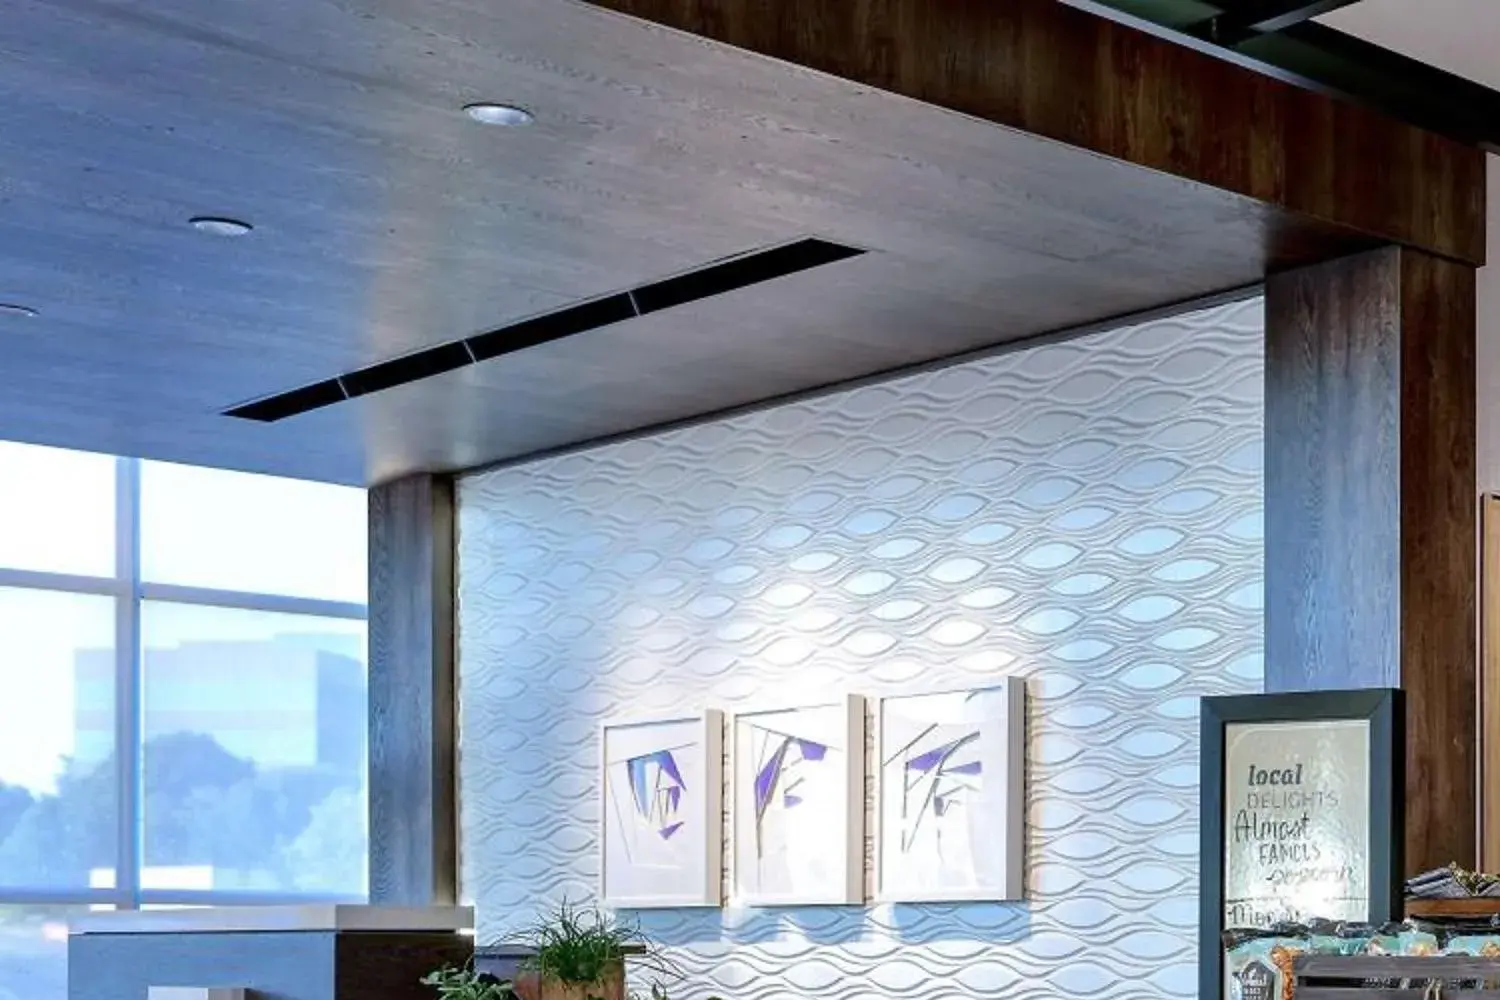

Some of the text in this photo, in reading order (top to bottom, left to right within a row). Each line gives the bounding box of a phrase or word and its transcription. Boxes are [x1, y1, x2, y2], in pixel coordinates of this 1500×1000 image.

[1248, 763, 1303, 786] local
[1247, 790, 1339, 810] DELIGHTS
[1234, 809, 1312, 842] Almost
